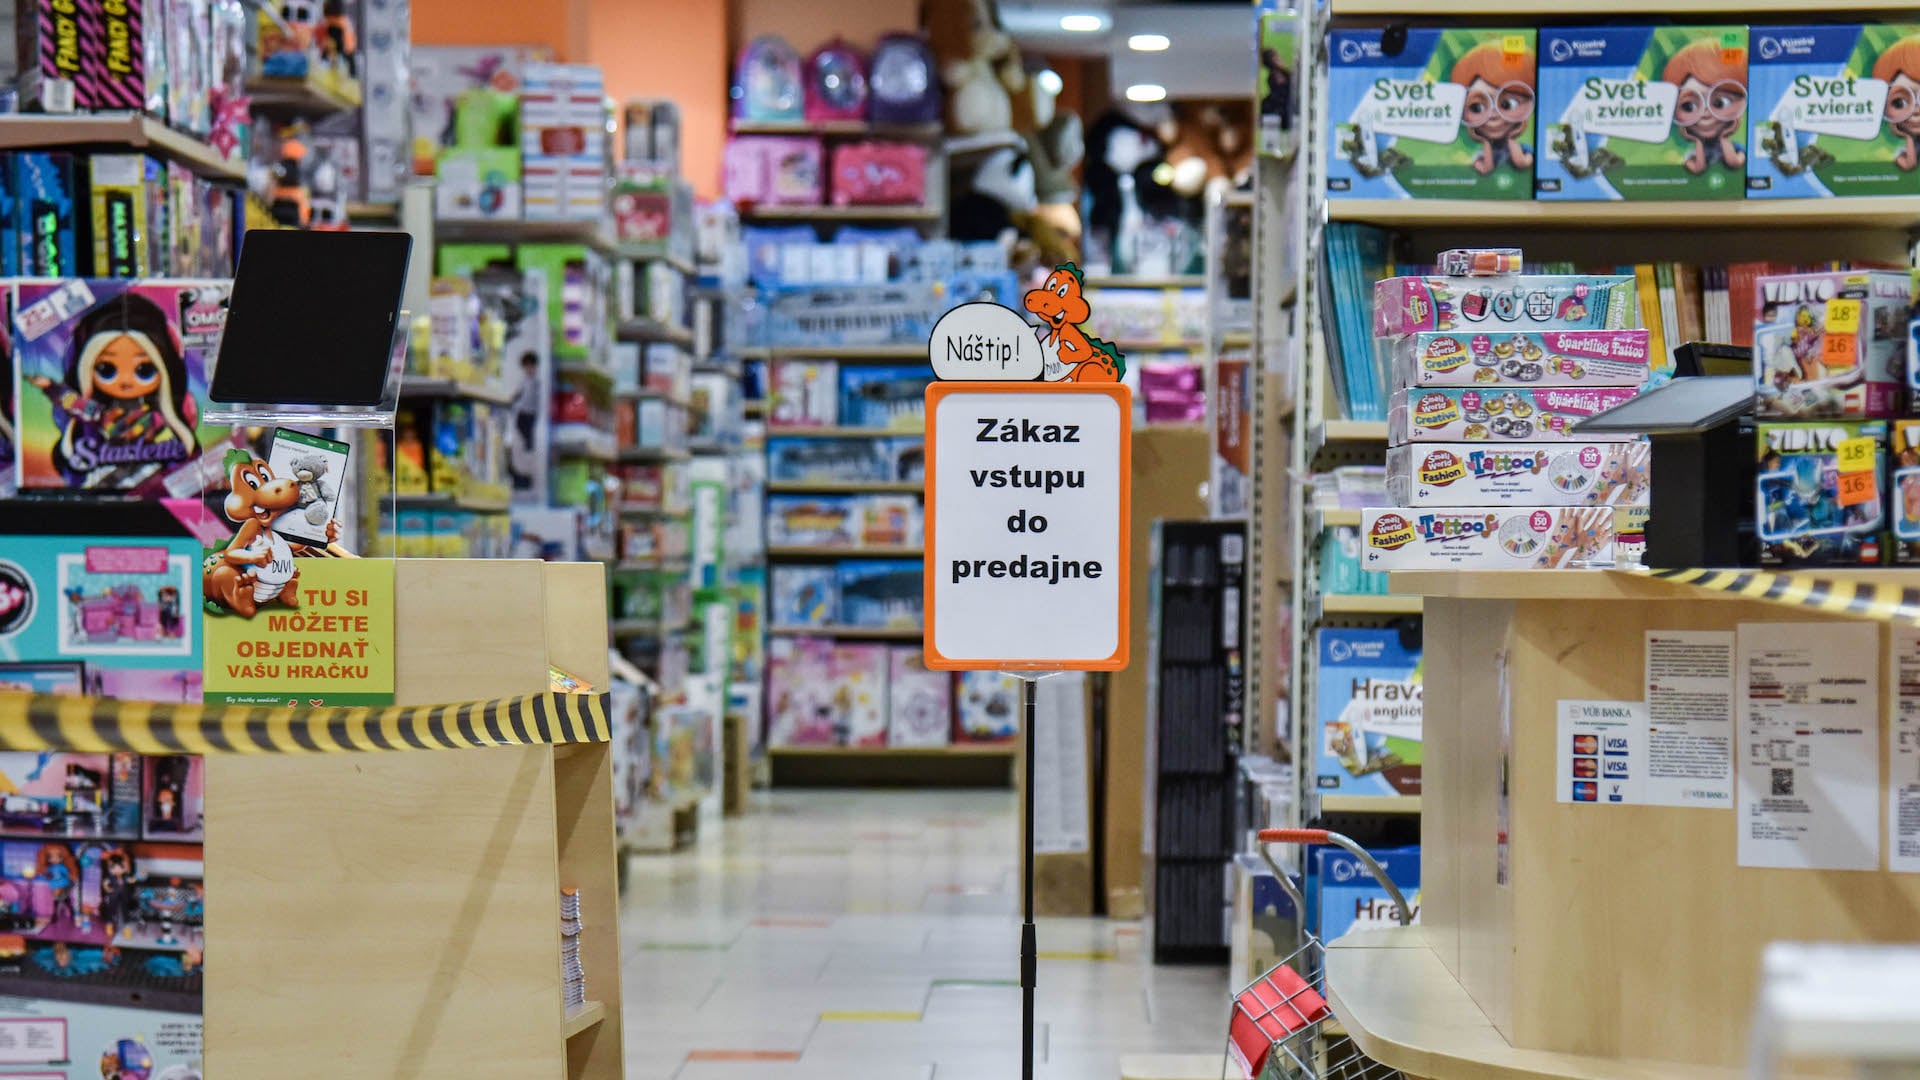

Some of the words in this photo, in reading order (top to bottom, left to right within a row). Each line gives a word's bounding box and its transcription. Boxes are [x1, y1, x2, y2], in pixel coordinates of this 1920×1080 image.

[1374, 79, 1435, 100] Svet
[1584, 77, 1647, 100] Svet
[1794, 74, 1857, 98] Svet
[1386, 104, 1452, 119] zvierat
[1597, 102, 1664, 118] zvierat
[1807, 98, 1874, 115] zvierat
[947, 334, 1020, 370] Náštip!
[1557, 334, 1609, 356] Sparkling
[1611, 341, 1644, 358] Tattoo
[1425, 355, 1466, 369] Creative
[1424, 373, 1433, 381] 5+
[1422, 394, 1444, 406] Small
[1422, 401, 1446, 413] World
[1547, 391, 1600, 413] Sparkling
[1415, 411, 1456, 425] Creative
[975, 418, 1080, 443] Zákaz
[1413, 428, 1423, 437] 5+
[1427, 459, 1453, 471] World
[1428, 453, 1451, 464] Small
[1468, 450, 1545, 475] Tattoos
[969, 464, 1085, 495] vstupu
[1422, 468, 1462, 482] Fashion
[1418, 488, 1430, 498] 6+
[1007, 509, 1048, 534] do
[1377, 516, 1401, 527] Small
[1377, 522, 1403, 534] World
[1418, 514, 1496, 538] Tattoos
[1372, 532, 1412, 546] Fashion
[1368, 552, 1379, 561] 6+
[271, 559, 291, 574] DUVI
[952, 554, 1103, 585] predajne
[303, 589, 337, 606] TU
[345, 589, 369, 606] SI
[268, 611, 369, 632] MÔŽETE
[236, 638, 369, 659] OBJEDNAŤ
[227, 662, 280, 679] VAŠU
[287, 662, 369, 679] HRAČKU
[1602, 707, 1632, 718] BANKA
[1607, 738, 1628, 748] VISA
[1607, 761, 1628, 771] VISA
